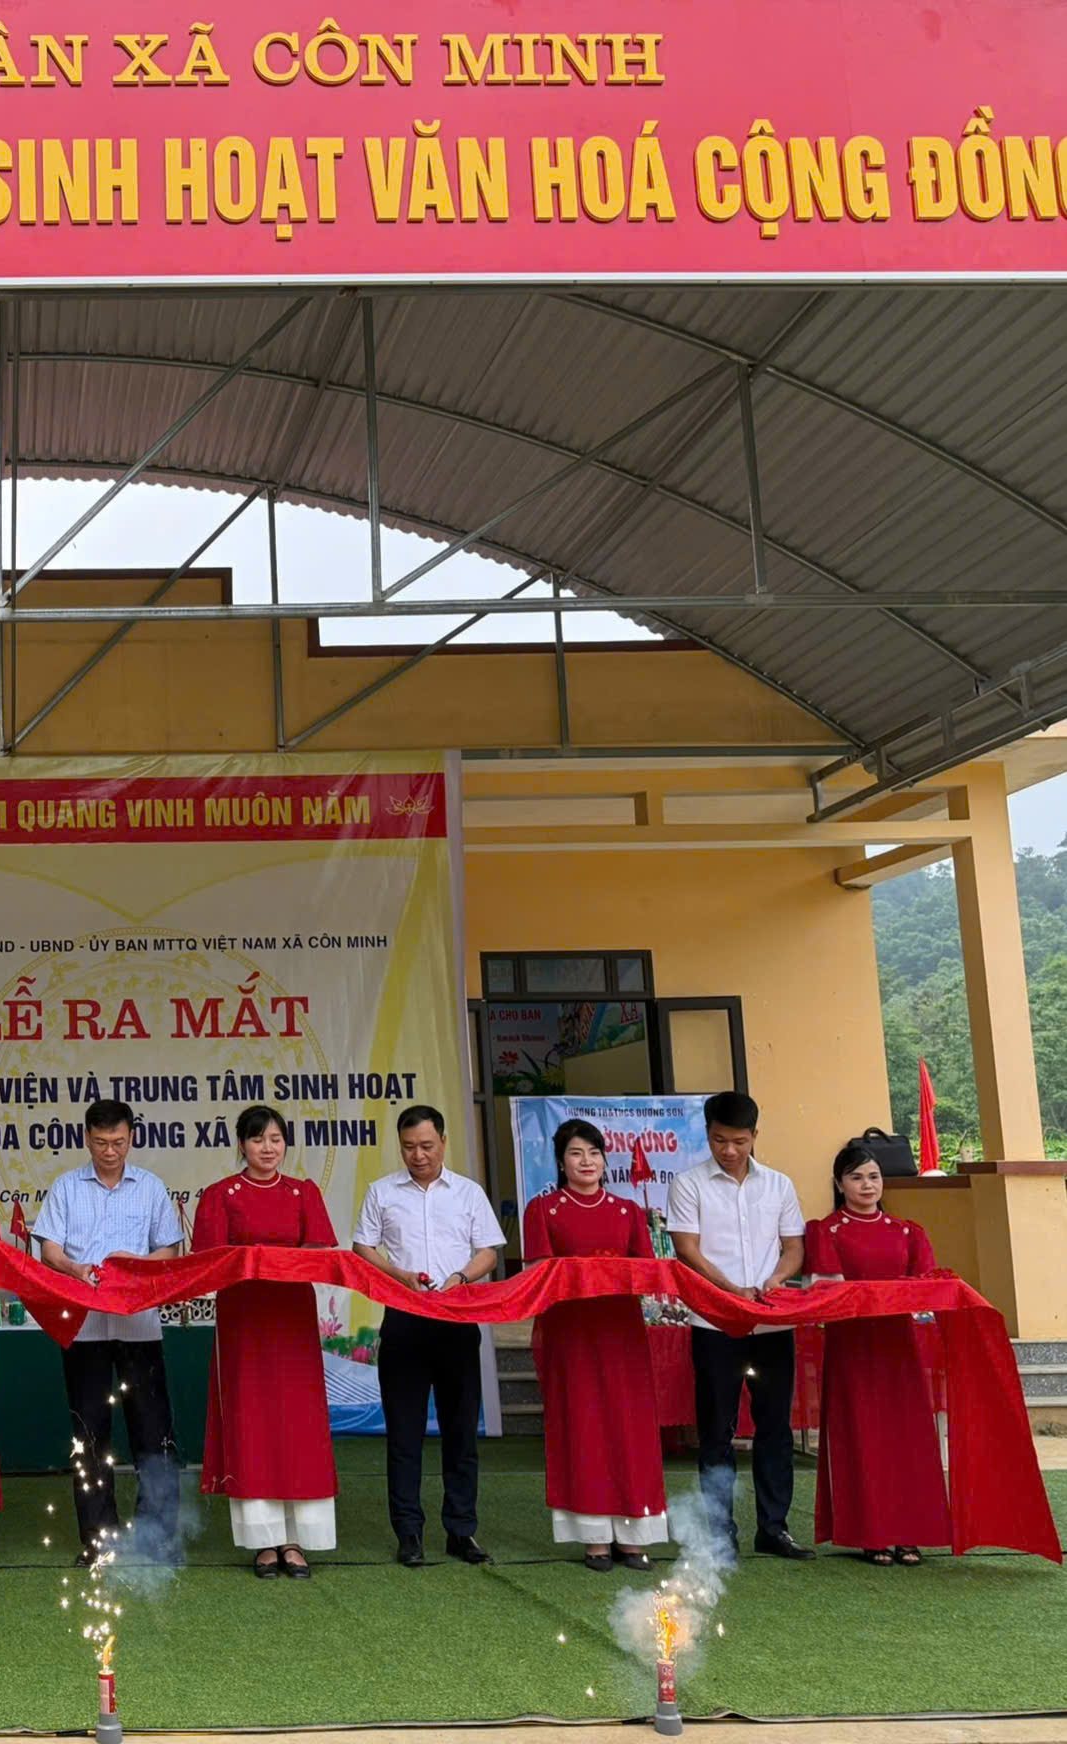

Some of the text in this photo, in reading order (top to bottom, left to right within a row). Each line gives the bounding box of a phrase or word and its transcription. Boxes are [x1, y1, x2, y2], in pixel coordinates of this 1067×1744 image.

[113, 23, 230, 86] XÃ
[253, 18, 418, 85] CÔN
[442, 33, 666, 85] MINH
[164, 136, 345, 242] HOẠT
[363, 119, 511, 223] VĂN
[531, 120, 678, 222] HOÁ
[694, 118, 890, 240] CỘNG
[907, 105, 1067, 222] ĐỒN
[17, 799, 116, 833] QUANG
[126, 799, 194, 828] VINH
[204, 793, 292, 827] MUÔN
[302, 791, 371, 825] NĂM
[30, 940, 74, 952] UBND
[89, 934, 109, 952] ỦY
[116, 939, 147, 951] BAN
[153, 939, 197, 951] MTTQ
[202, 935, 237, 953] VIỆT
[243, 937, 276, 949] NAM
[282, 934, 303, 949] XÃ
[309, 933, 341, 948] CÔN
[347, 936, 387, 947] MINH
[63, 998, 151, 1041] RA
[170, 971, 310, 1039] MẮT
[66, 1071, 101, 1103] VÀ
[109, 1076, 198, 1104] TRUNG
[206, 1069, 265, 1102] TÂM
[273, 1073, 339, 1101] SINH
[348, 1072, 417, 1106] HOẠT
[28, 1117, 84, 1156] CỘN
[132, 1113, 186, 1149] ỒNG
[194, 1116, 231, 1148] XÃ
[304, 1119, 377, 1147] MINH
[604, 1124, 678, 1153] ỞNG ỨNG
[0, 1189, 30, 1203] Côn
